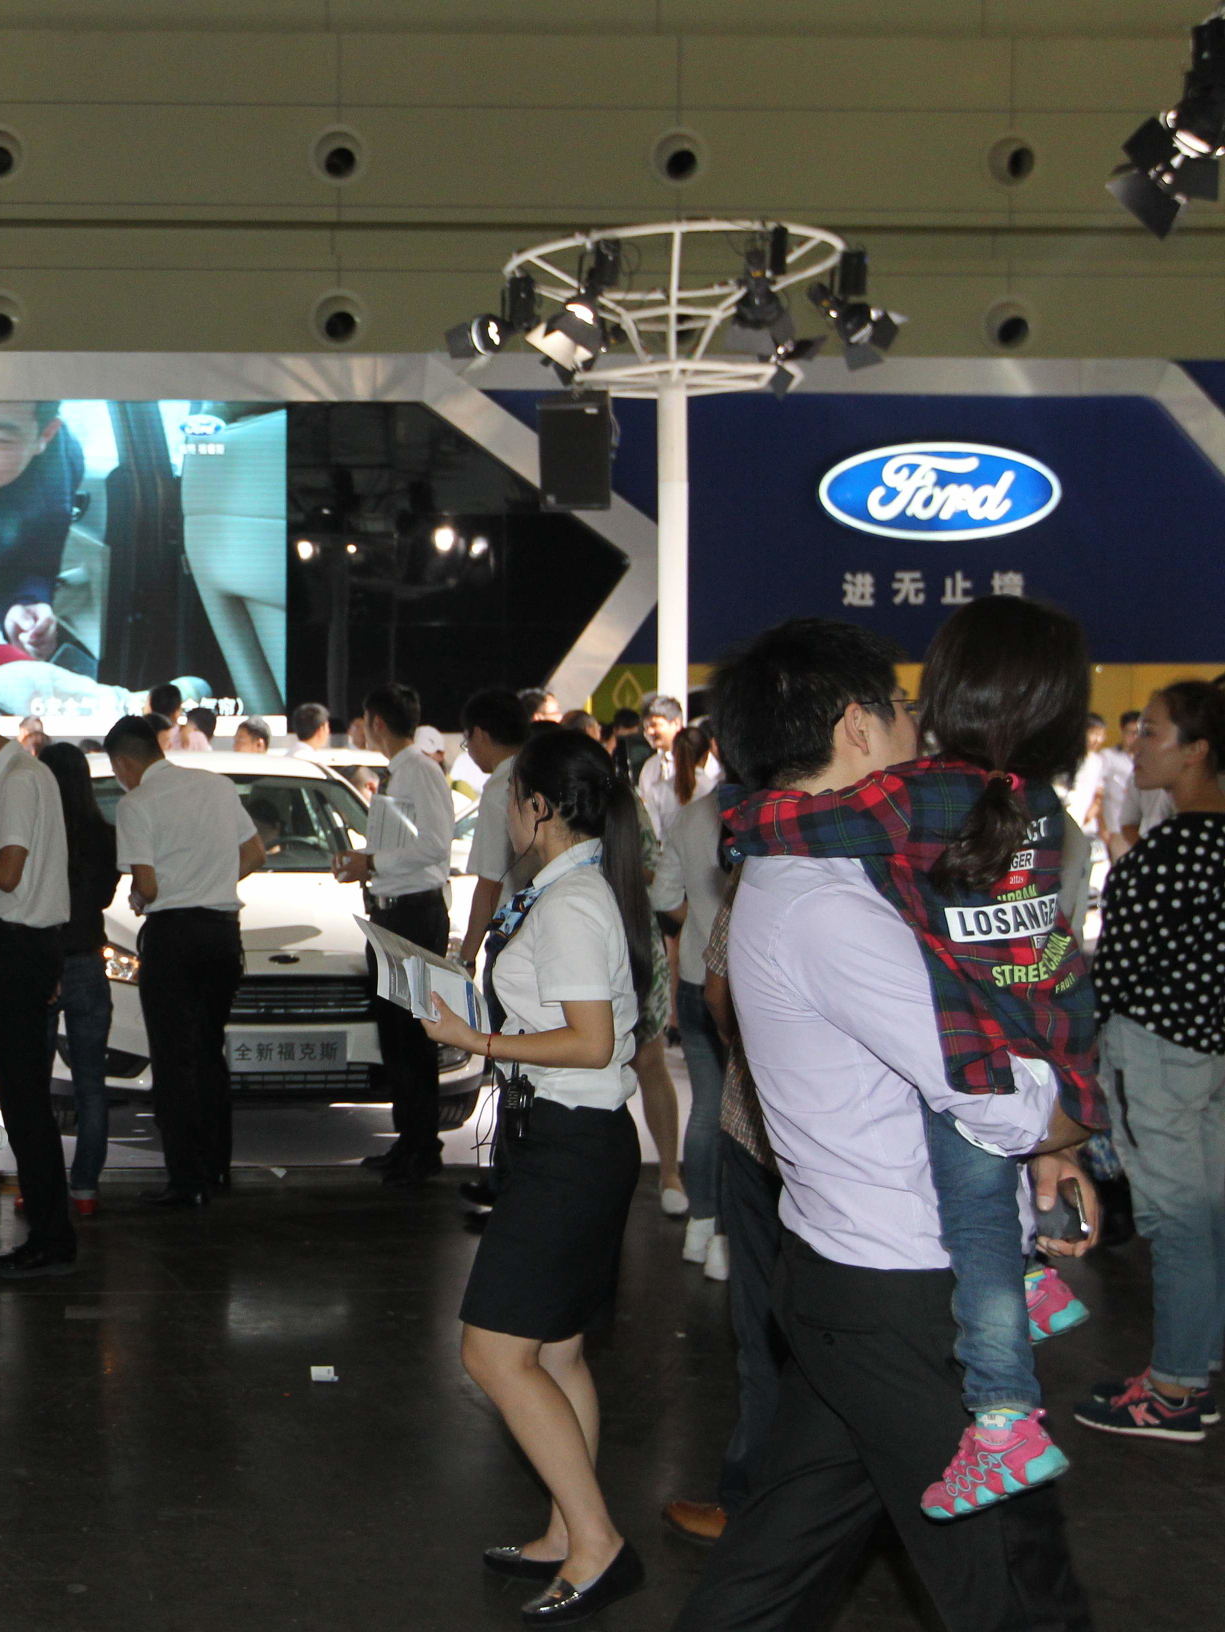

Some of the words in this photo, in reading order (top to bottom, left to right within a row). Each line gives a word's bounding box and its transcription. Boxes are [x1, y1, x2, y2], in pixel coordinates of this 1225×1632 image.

[867, 453, 1016, 521] Ford
[234, 1042, 339, 1062] 全新福克斯
